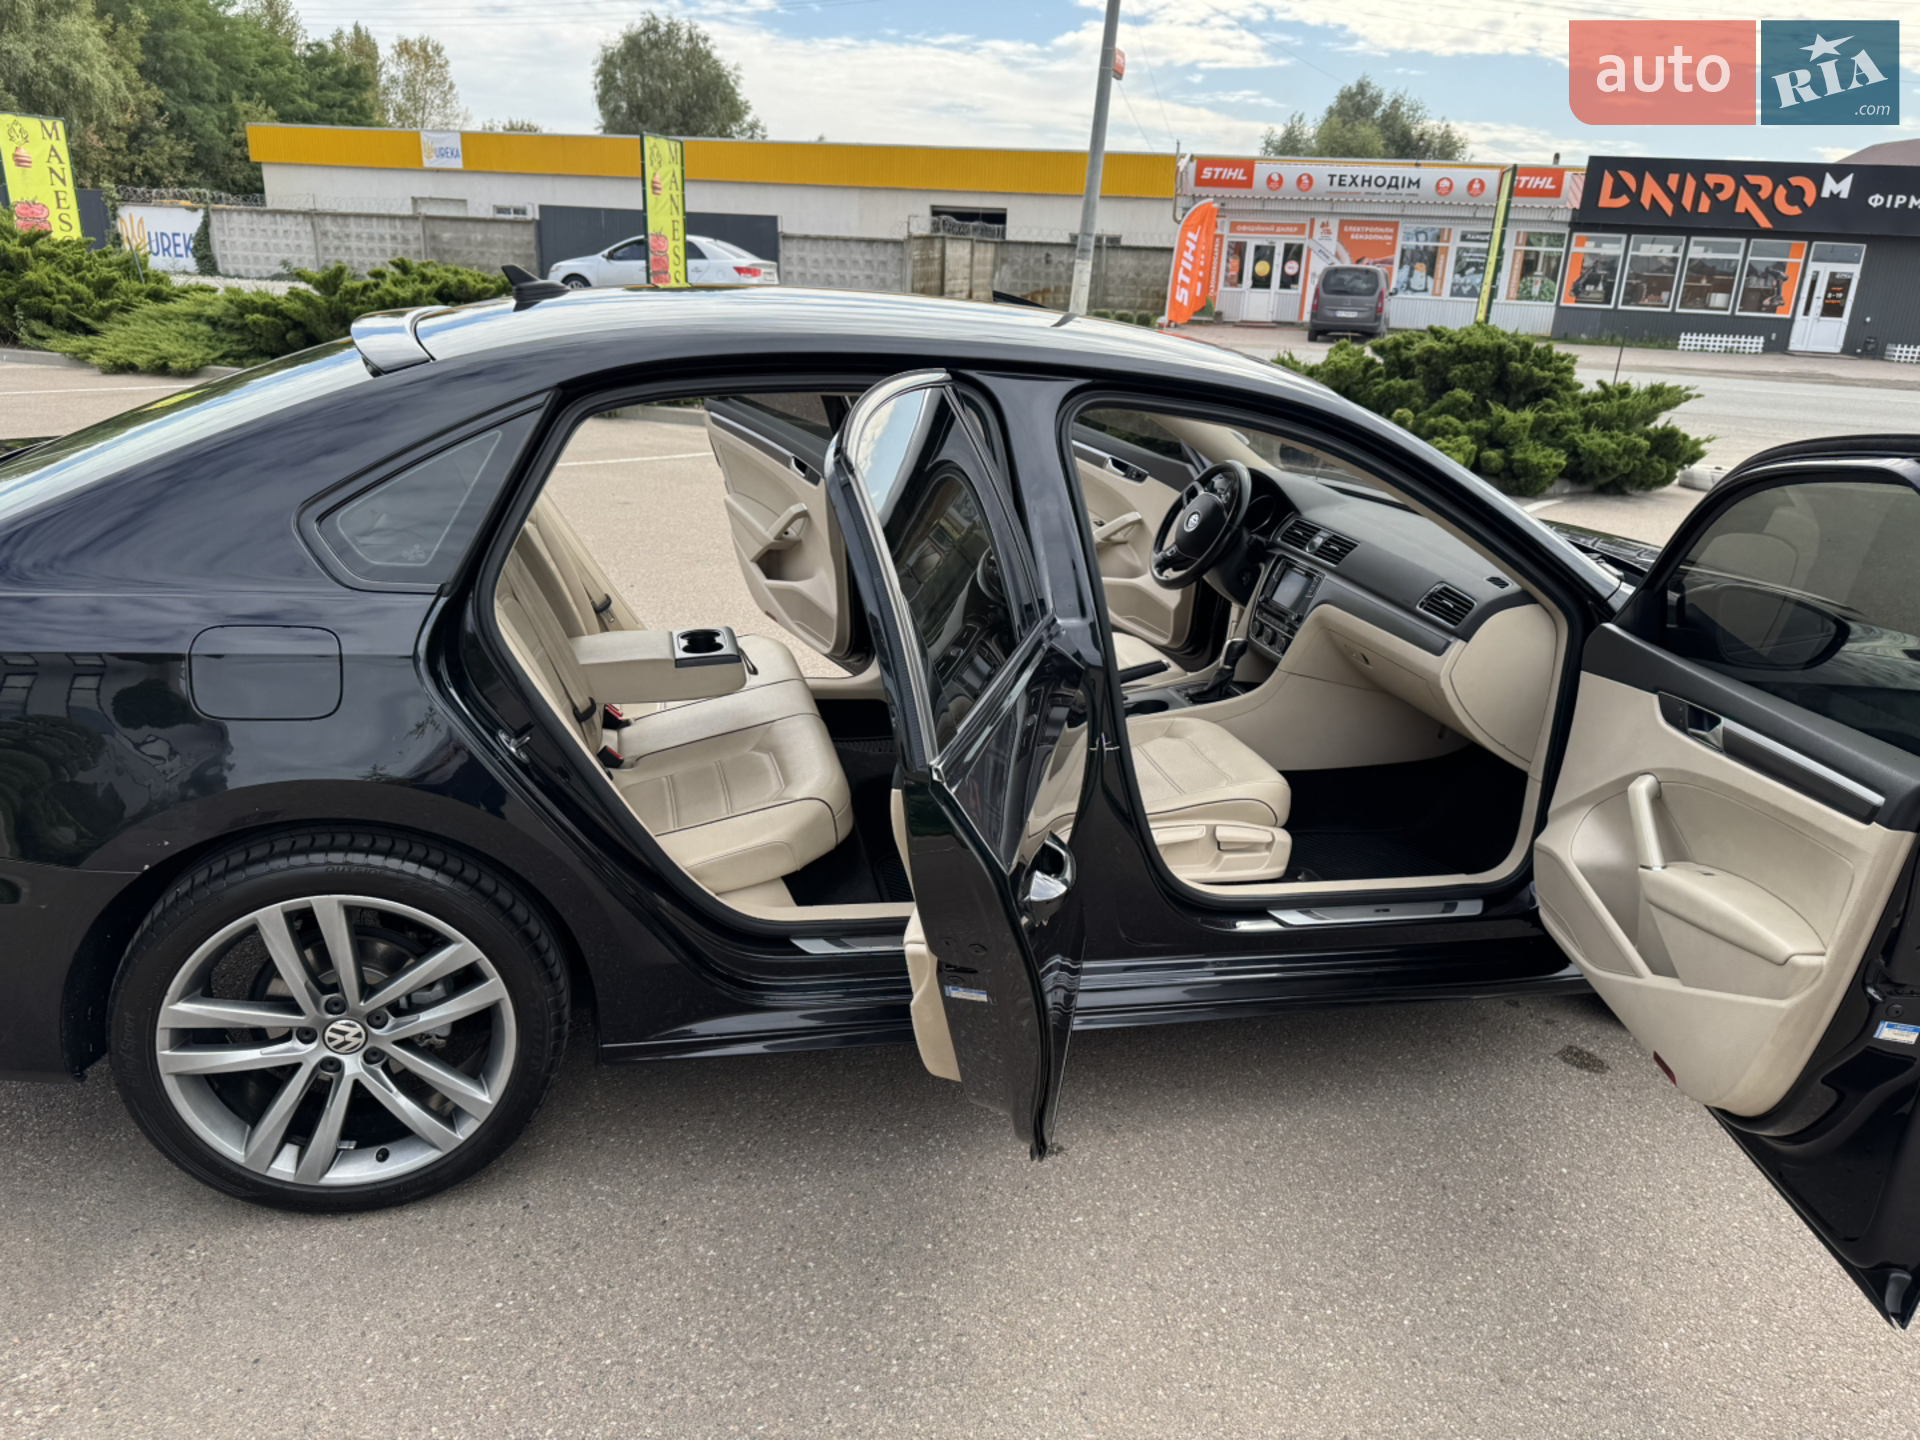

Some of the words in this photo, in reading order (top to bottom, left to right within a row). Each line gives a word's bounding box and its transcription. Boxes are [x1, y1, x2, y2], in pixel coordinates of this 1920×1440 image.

[1200, 166, 1248, 181] STIHL
[1327, 173, 1422, 190] ТЕХНОДІМ
[668, 141, 681, 285] MANESS
[1598, 169, 1818, 229] DNIPRO
[147, 231, 195, 259] UREK
[1175, 225, 1202, 307] STIHL
